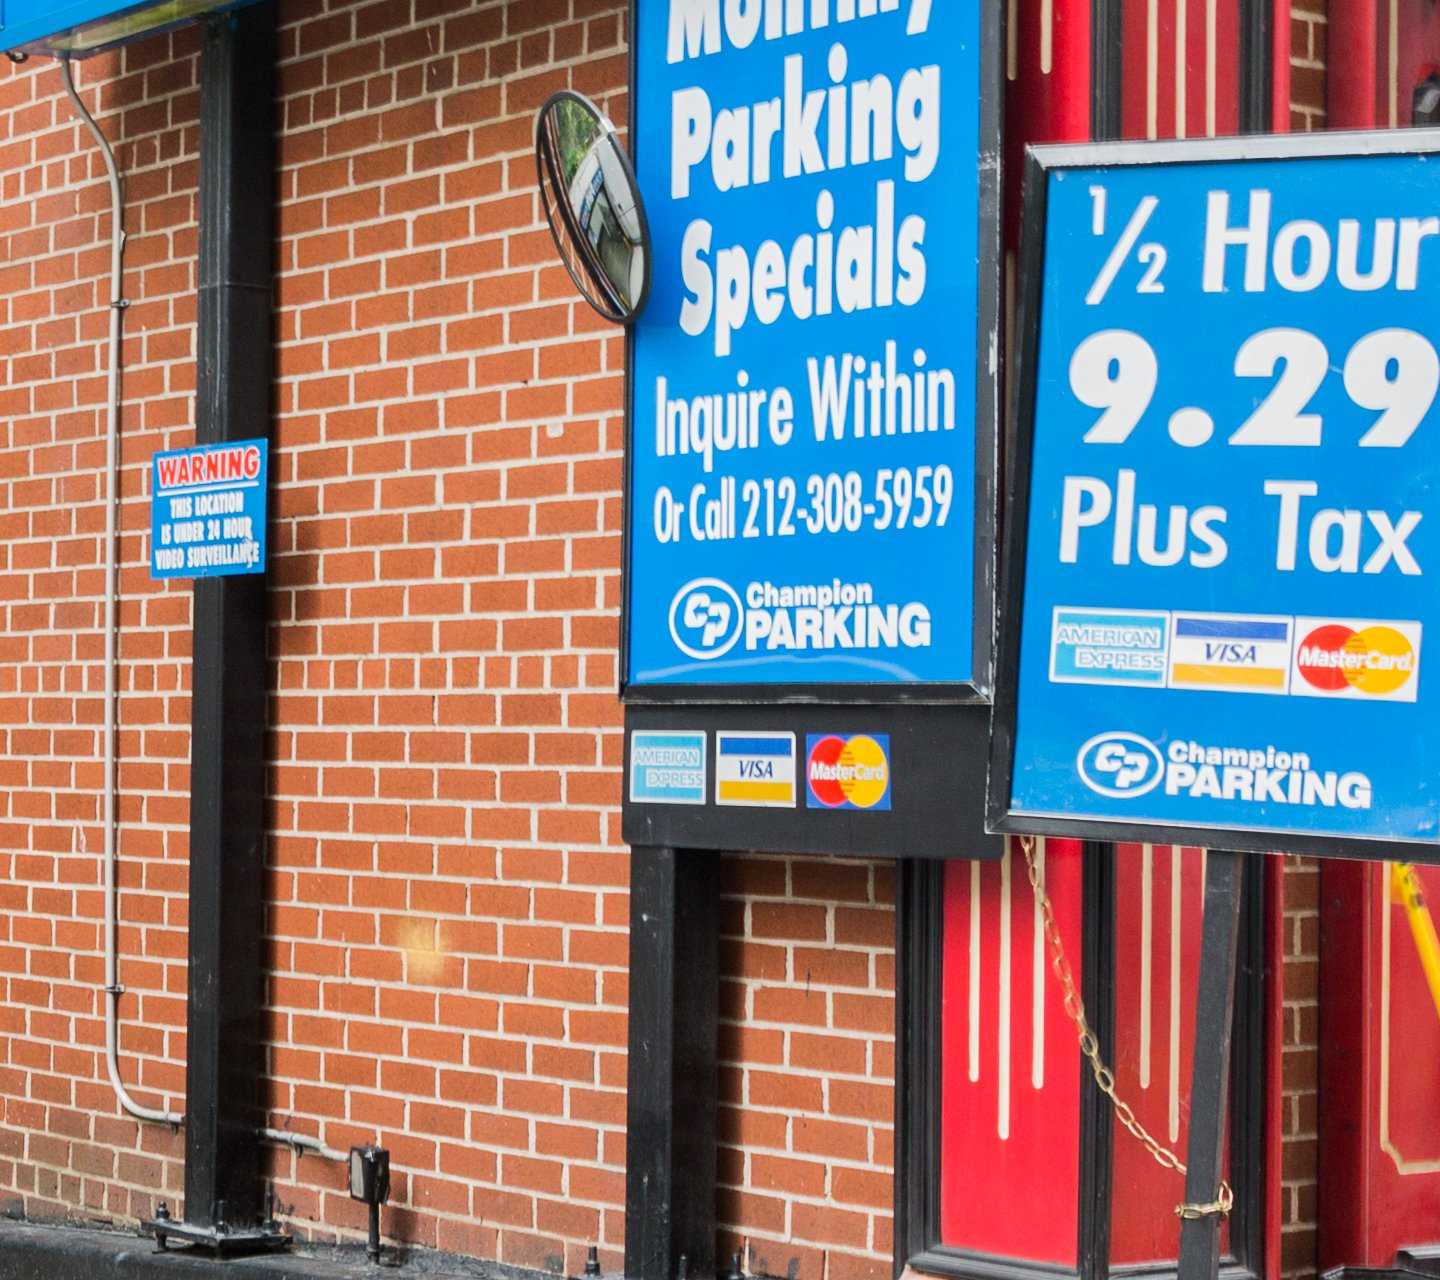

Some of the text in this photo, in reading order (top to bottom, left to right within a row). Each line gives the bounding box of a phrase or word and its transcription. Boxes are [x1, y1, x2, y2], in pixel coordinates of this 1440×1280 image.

[672, 44, 939, 198] Parking
[1203, 190, 1440, 292] Hour
[680, 180, 925, 356] Specials
[1070, 328, 1440, 447] 9.29
[656, 341, 954, 472] Inquire Within
[157, 445, 261, 488] WARNING
[170, 491, 244, 519] THIS LOCATION
[655, 465, 952, 543] Or Call 212-308-5959
[161, 517, 253, 545] IS UNDER 24 HOUR
[1060, 470, 1422, 575] Plus Tax
[155, 542, 259, 570] VIDEO SURVEILLANCE
[746, 578, 872, 610] Champion
[745, 601, 931, 651] PARKING
[1056, 623, 1158, 647] AMERICAN
[1077, 648, 1164, 670] EXPRESS
[1204, 642, 1257, 663] VISA
[1299, 645, 1413, 672] MasterCard
[633, 750, 698, 766] AMERICAN
[739, 760, 774, 779] VISA
[1168, 740, 1310, 770] Champion
[647, 771, 703, 787] EXPRESS
[810, 761, 884, 782] MasterCard
[1165, 763, 1373, 809] PARKING
